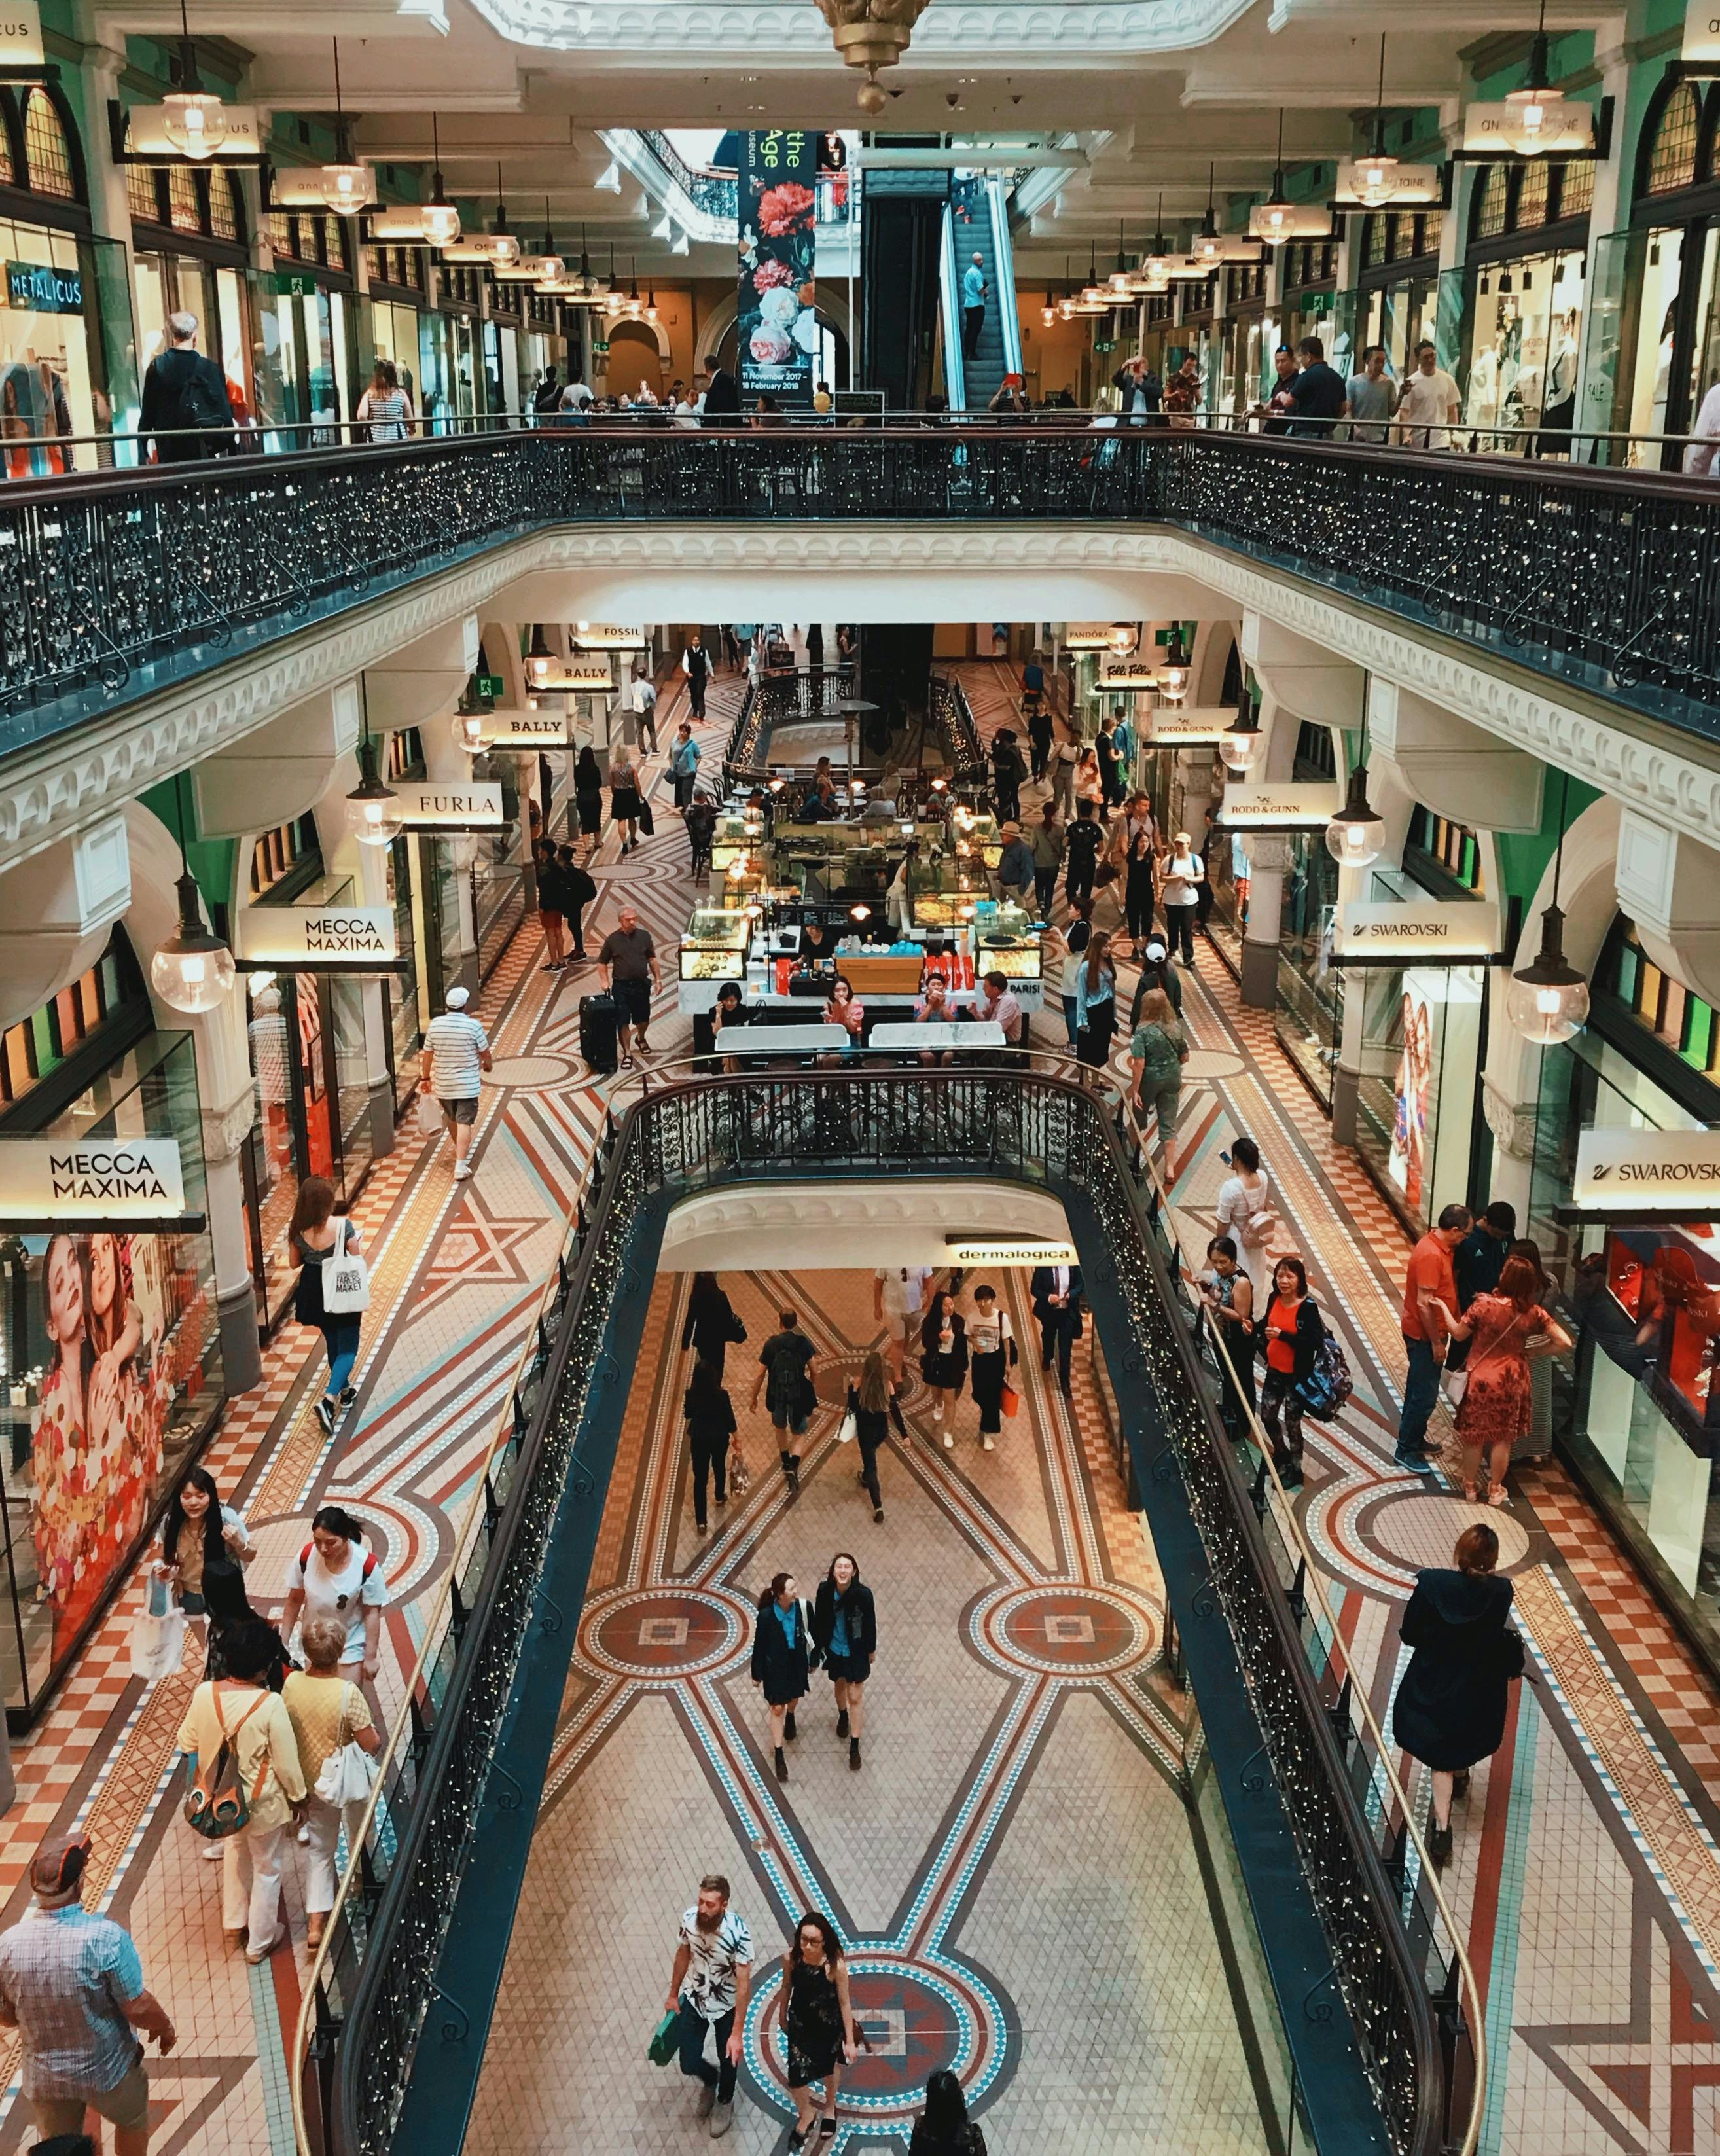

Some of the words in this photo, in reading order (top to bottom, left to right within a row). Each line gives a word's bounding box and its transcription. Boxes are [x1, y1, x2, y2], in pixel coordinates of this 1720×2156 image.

[760, 130, 783, 168] Age
[787, 131, 806, 168] the
[11, 274, 81, 304] METALICUS
[751, 382, 781, 391] February
[604, 628, 640, 636] FOSSIL
[565, 668, 607, 679] BALLY
[1107, 664, 1126, 680] Folli
[1128, 664, 1151, 678] Follie
[511, 721, 562, 732] BALLY
[420, 796, 495, 812] FURLA
[306, 919, 377, 935] MECCA
[1371, 924, 1448, 937] SWAROVSKI
[307, 937, 385, 951] MAXIMA
[1010, 984, 1041, 994] PARISI
[50, 1153, 154, 1175] MECCA
[1619, 1164, 1720, 1181] SWAROVSK
[53, 1178, 168, 1198] MAXIMA
[959, 1249, 1070, 1260] dermalogica
